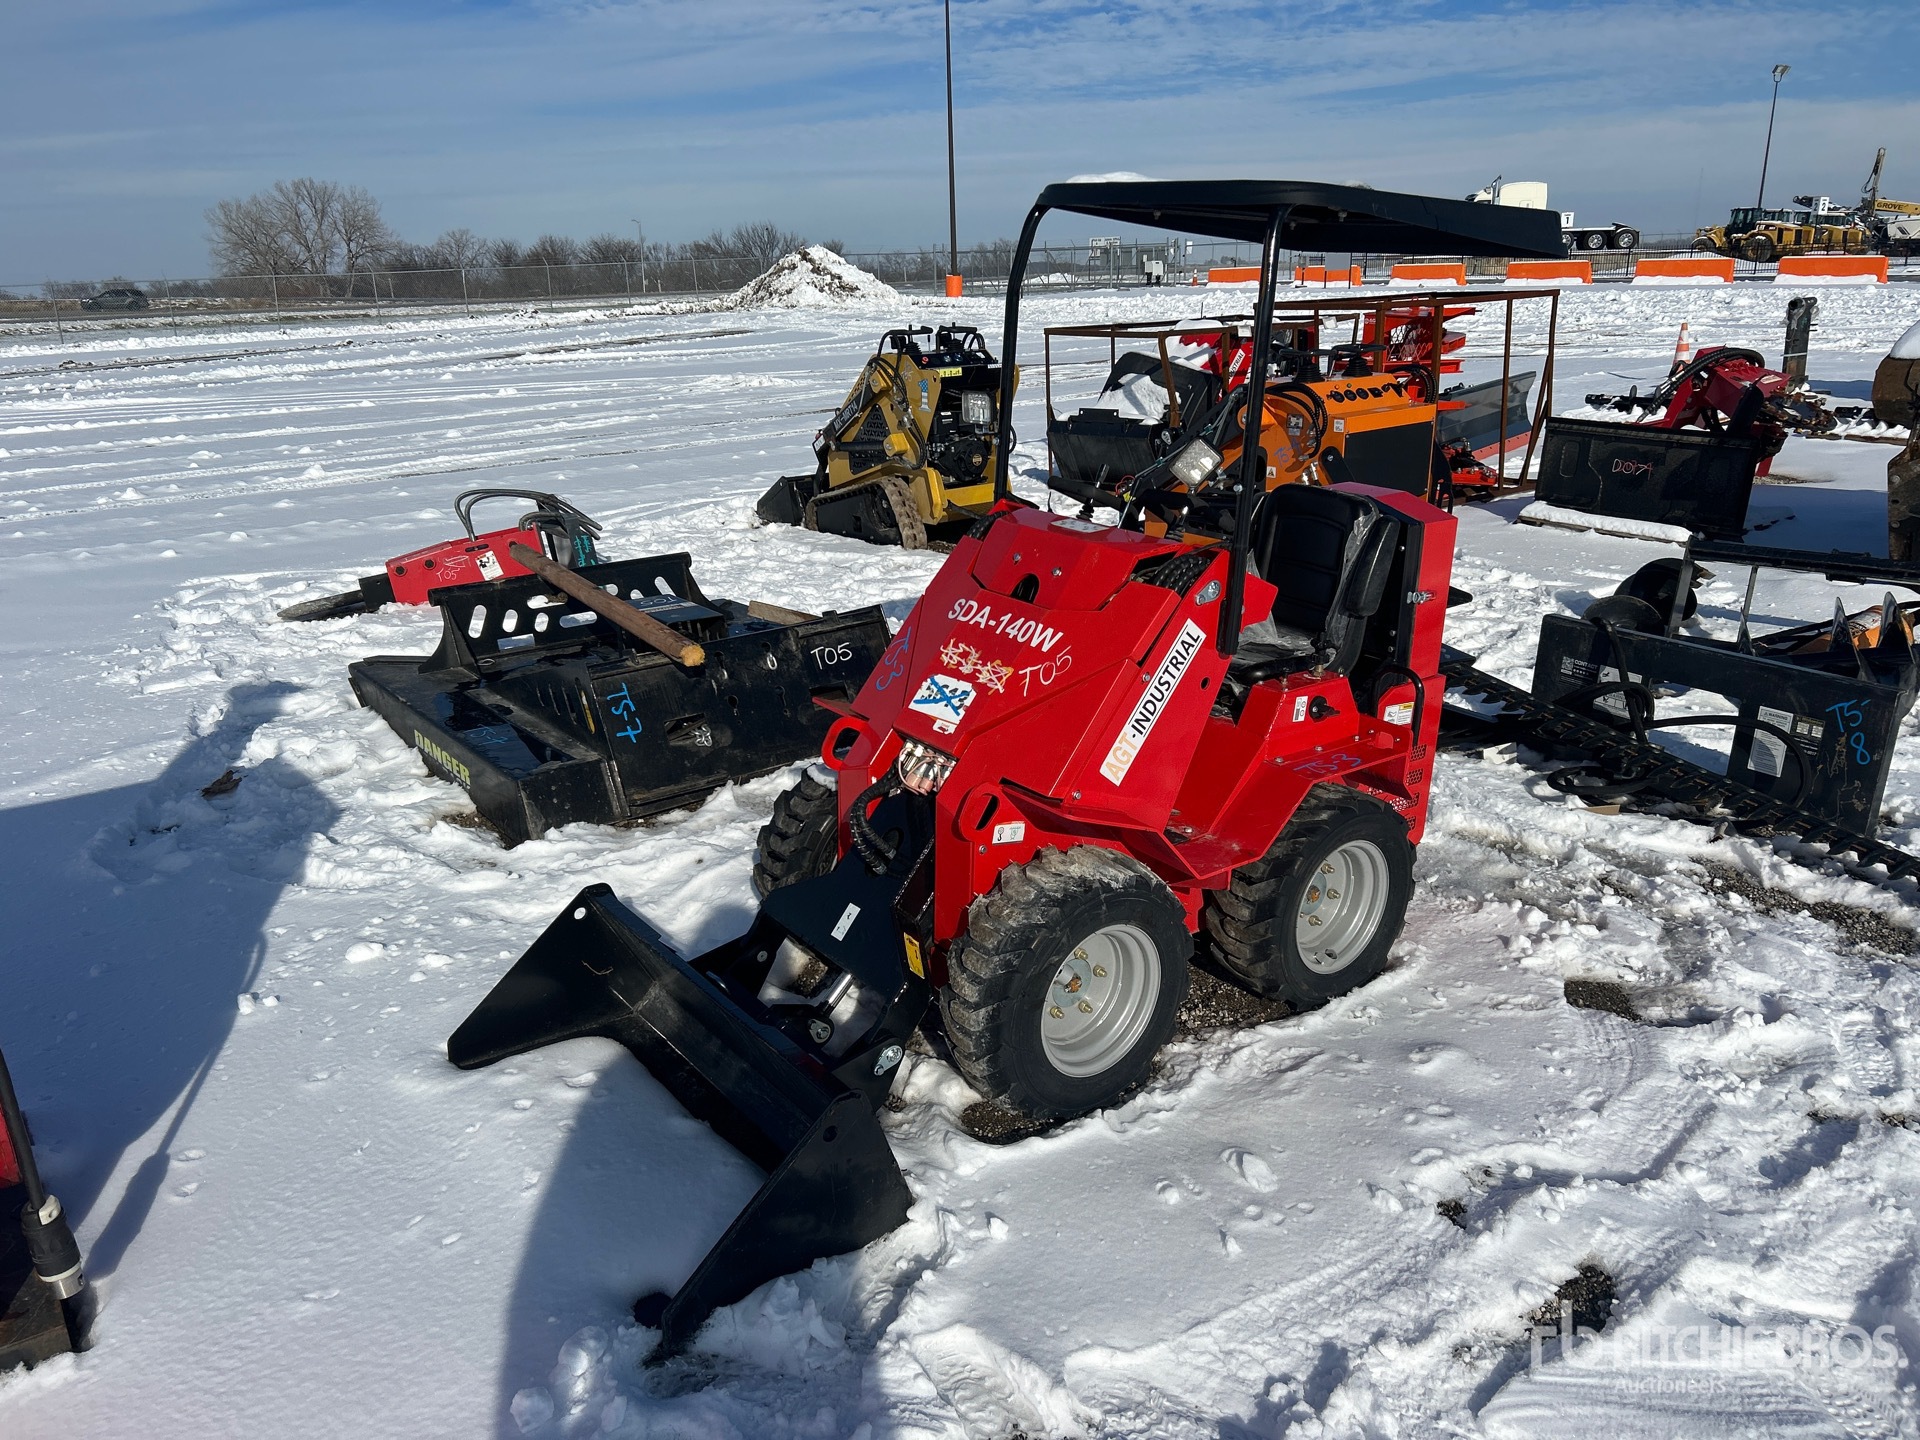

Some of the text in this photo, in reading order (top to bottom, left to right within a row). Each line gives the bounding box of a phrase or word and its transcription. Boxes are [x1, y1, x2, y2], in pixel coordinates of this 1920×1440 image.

[1876, 202, 1904, 210] GROVE
[948, 598, 1063, 653] SDA-140W
[414, 729, 471, 787] DANGER
